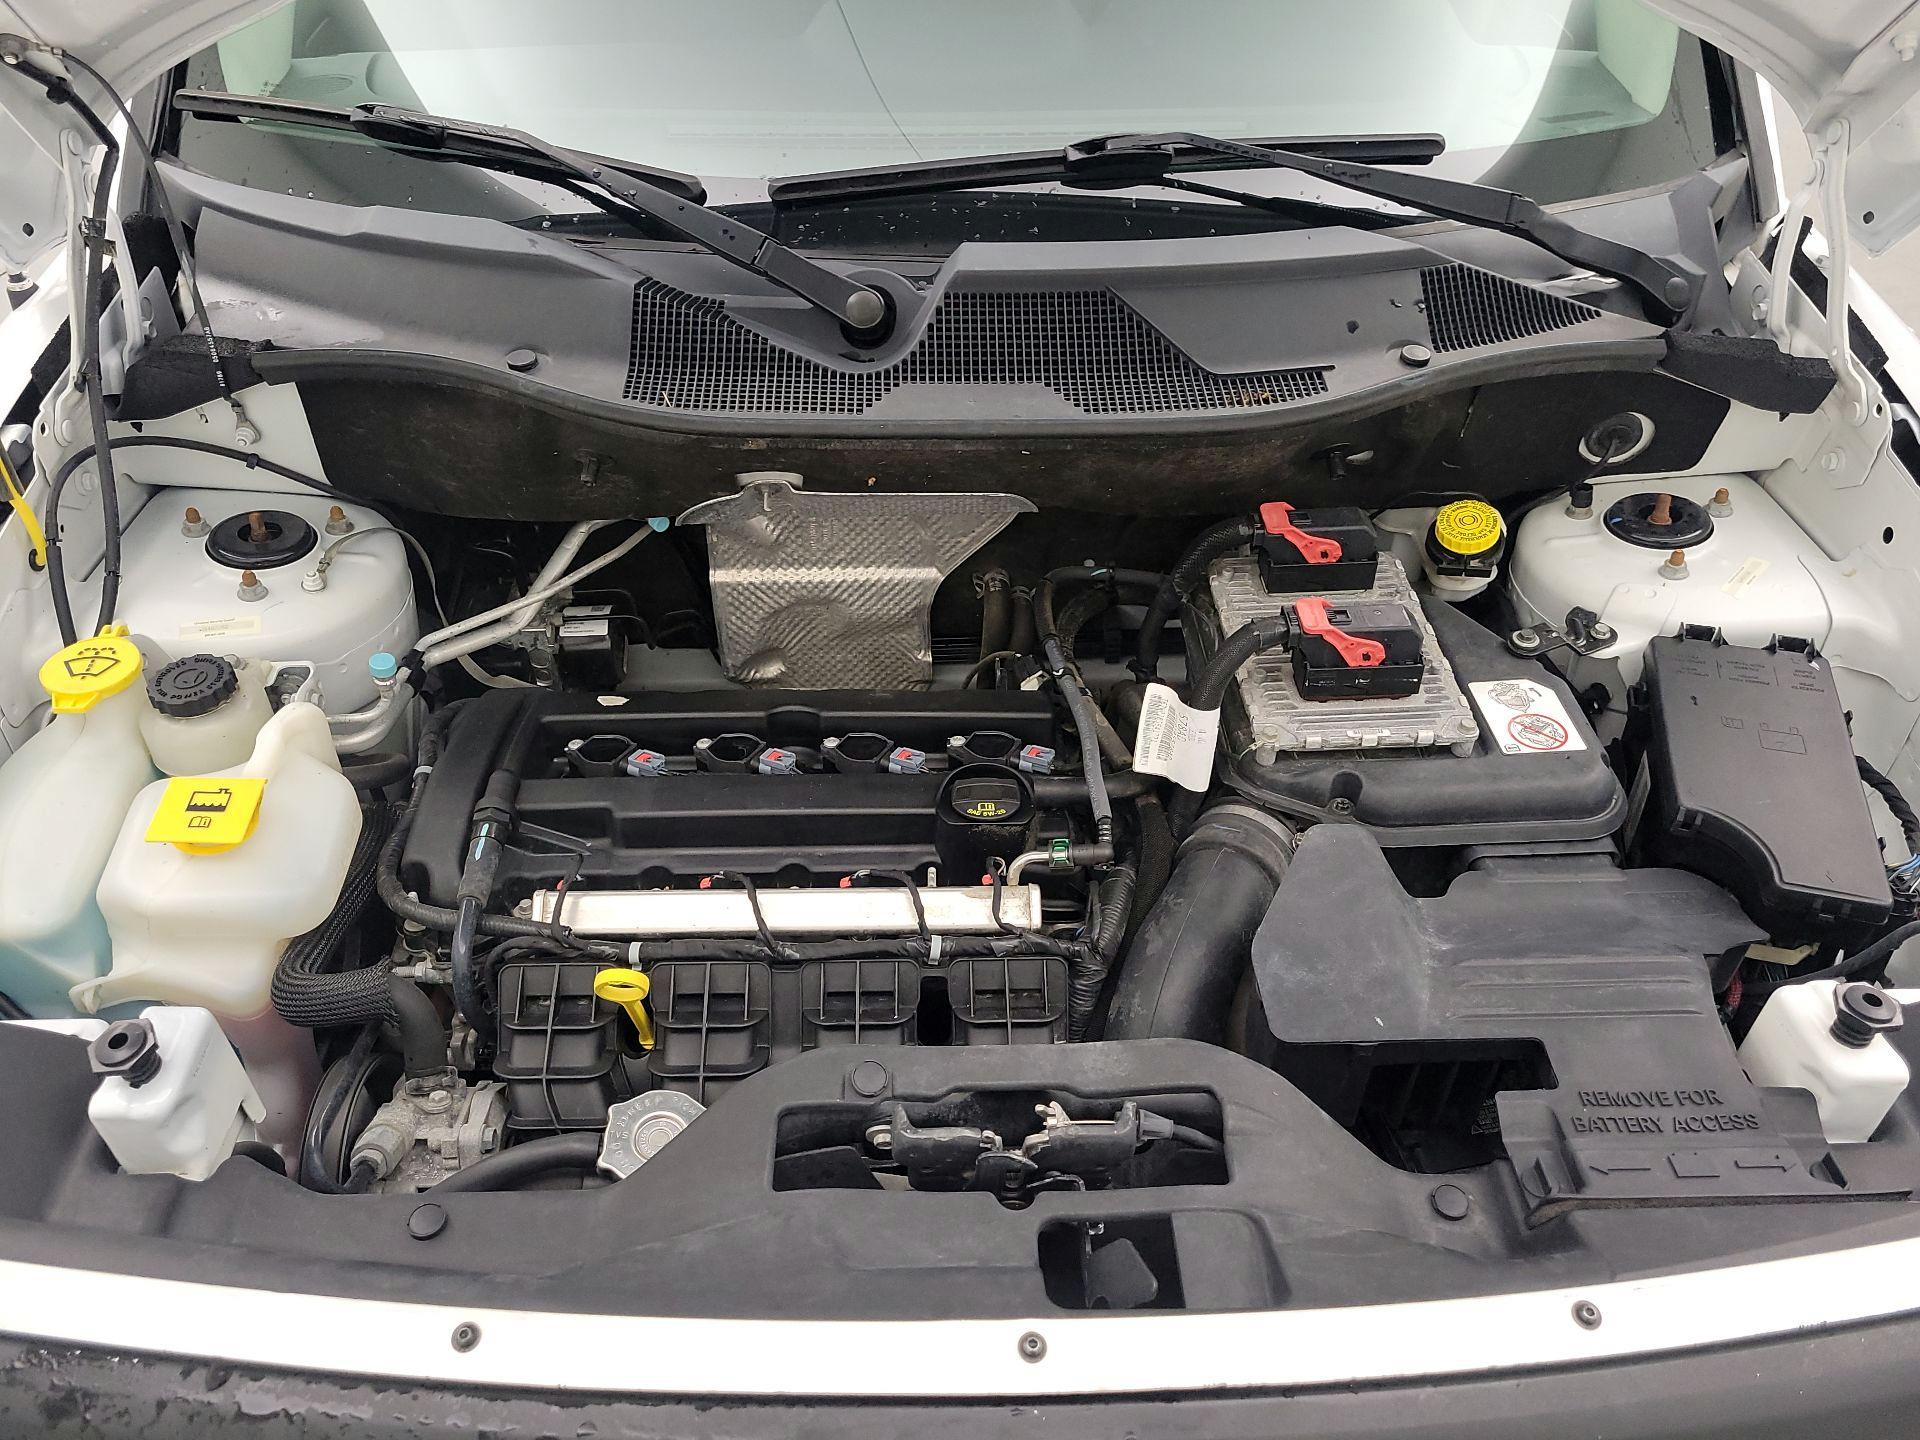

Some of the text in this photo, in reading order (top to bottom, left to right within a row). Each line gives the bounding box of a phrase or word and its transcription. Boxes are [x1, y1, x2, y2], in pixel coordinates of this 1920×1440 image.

[1578, 1088, 1724, 1107] REMOVE FOR
[1570, 1112, 1761, 1133] BATTERY ACCESS
